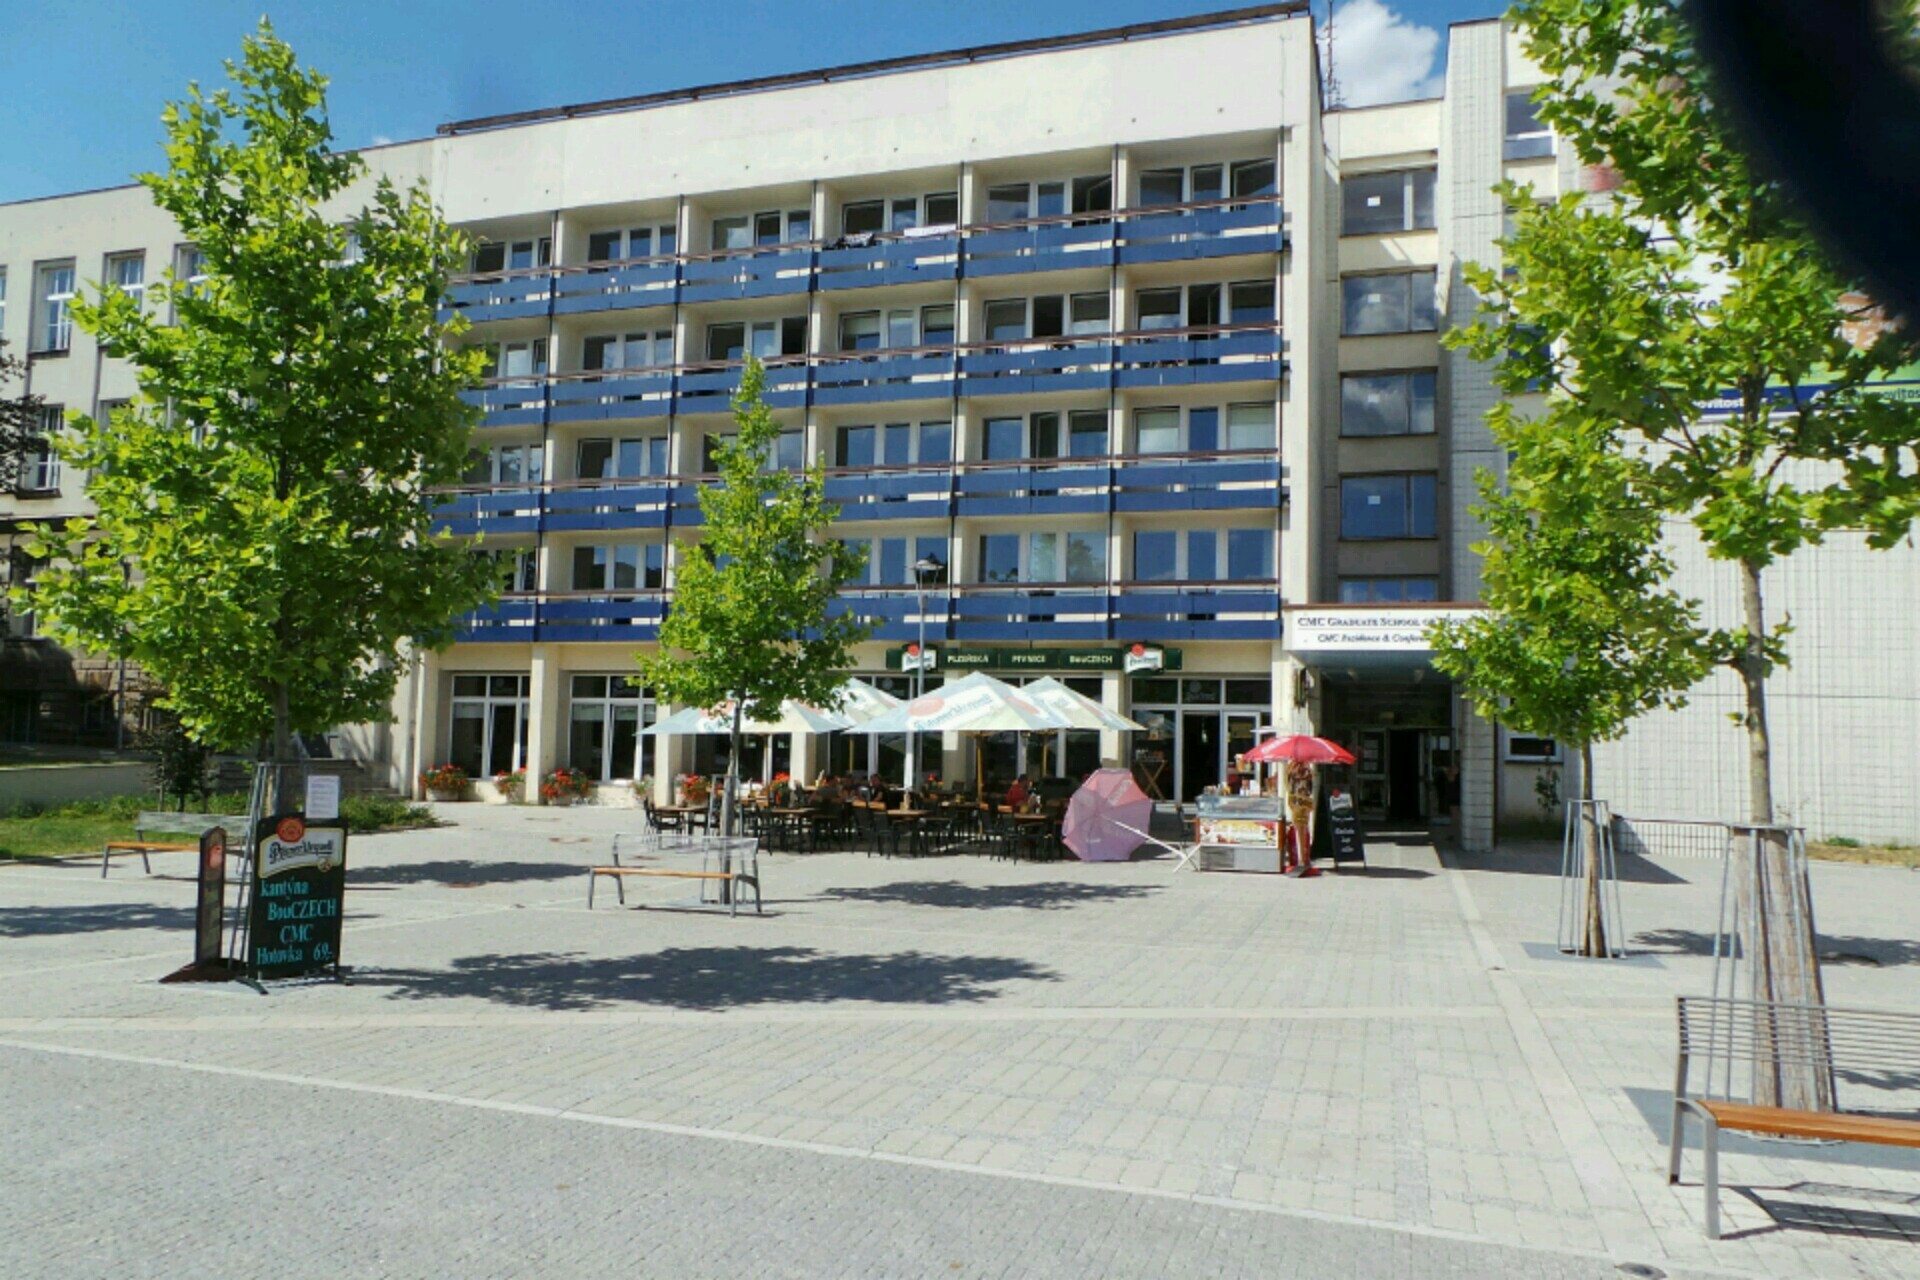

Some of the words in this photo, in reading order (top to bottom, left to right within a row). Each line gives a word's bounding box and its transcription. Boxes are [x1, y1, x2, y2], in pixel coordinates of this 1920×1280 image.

[1297, 617, 1325, 627] CMC
[1318, 633, 1340, 643] CMC
[280, 924, 314, 943] CMC
